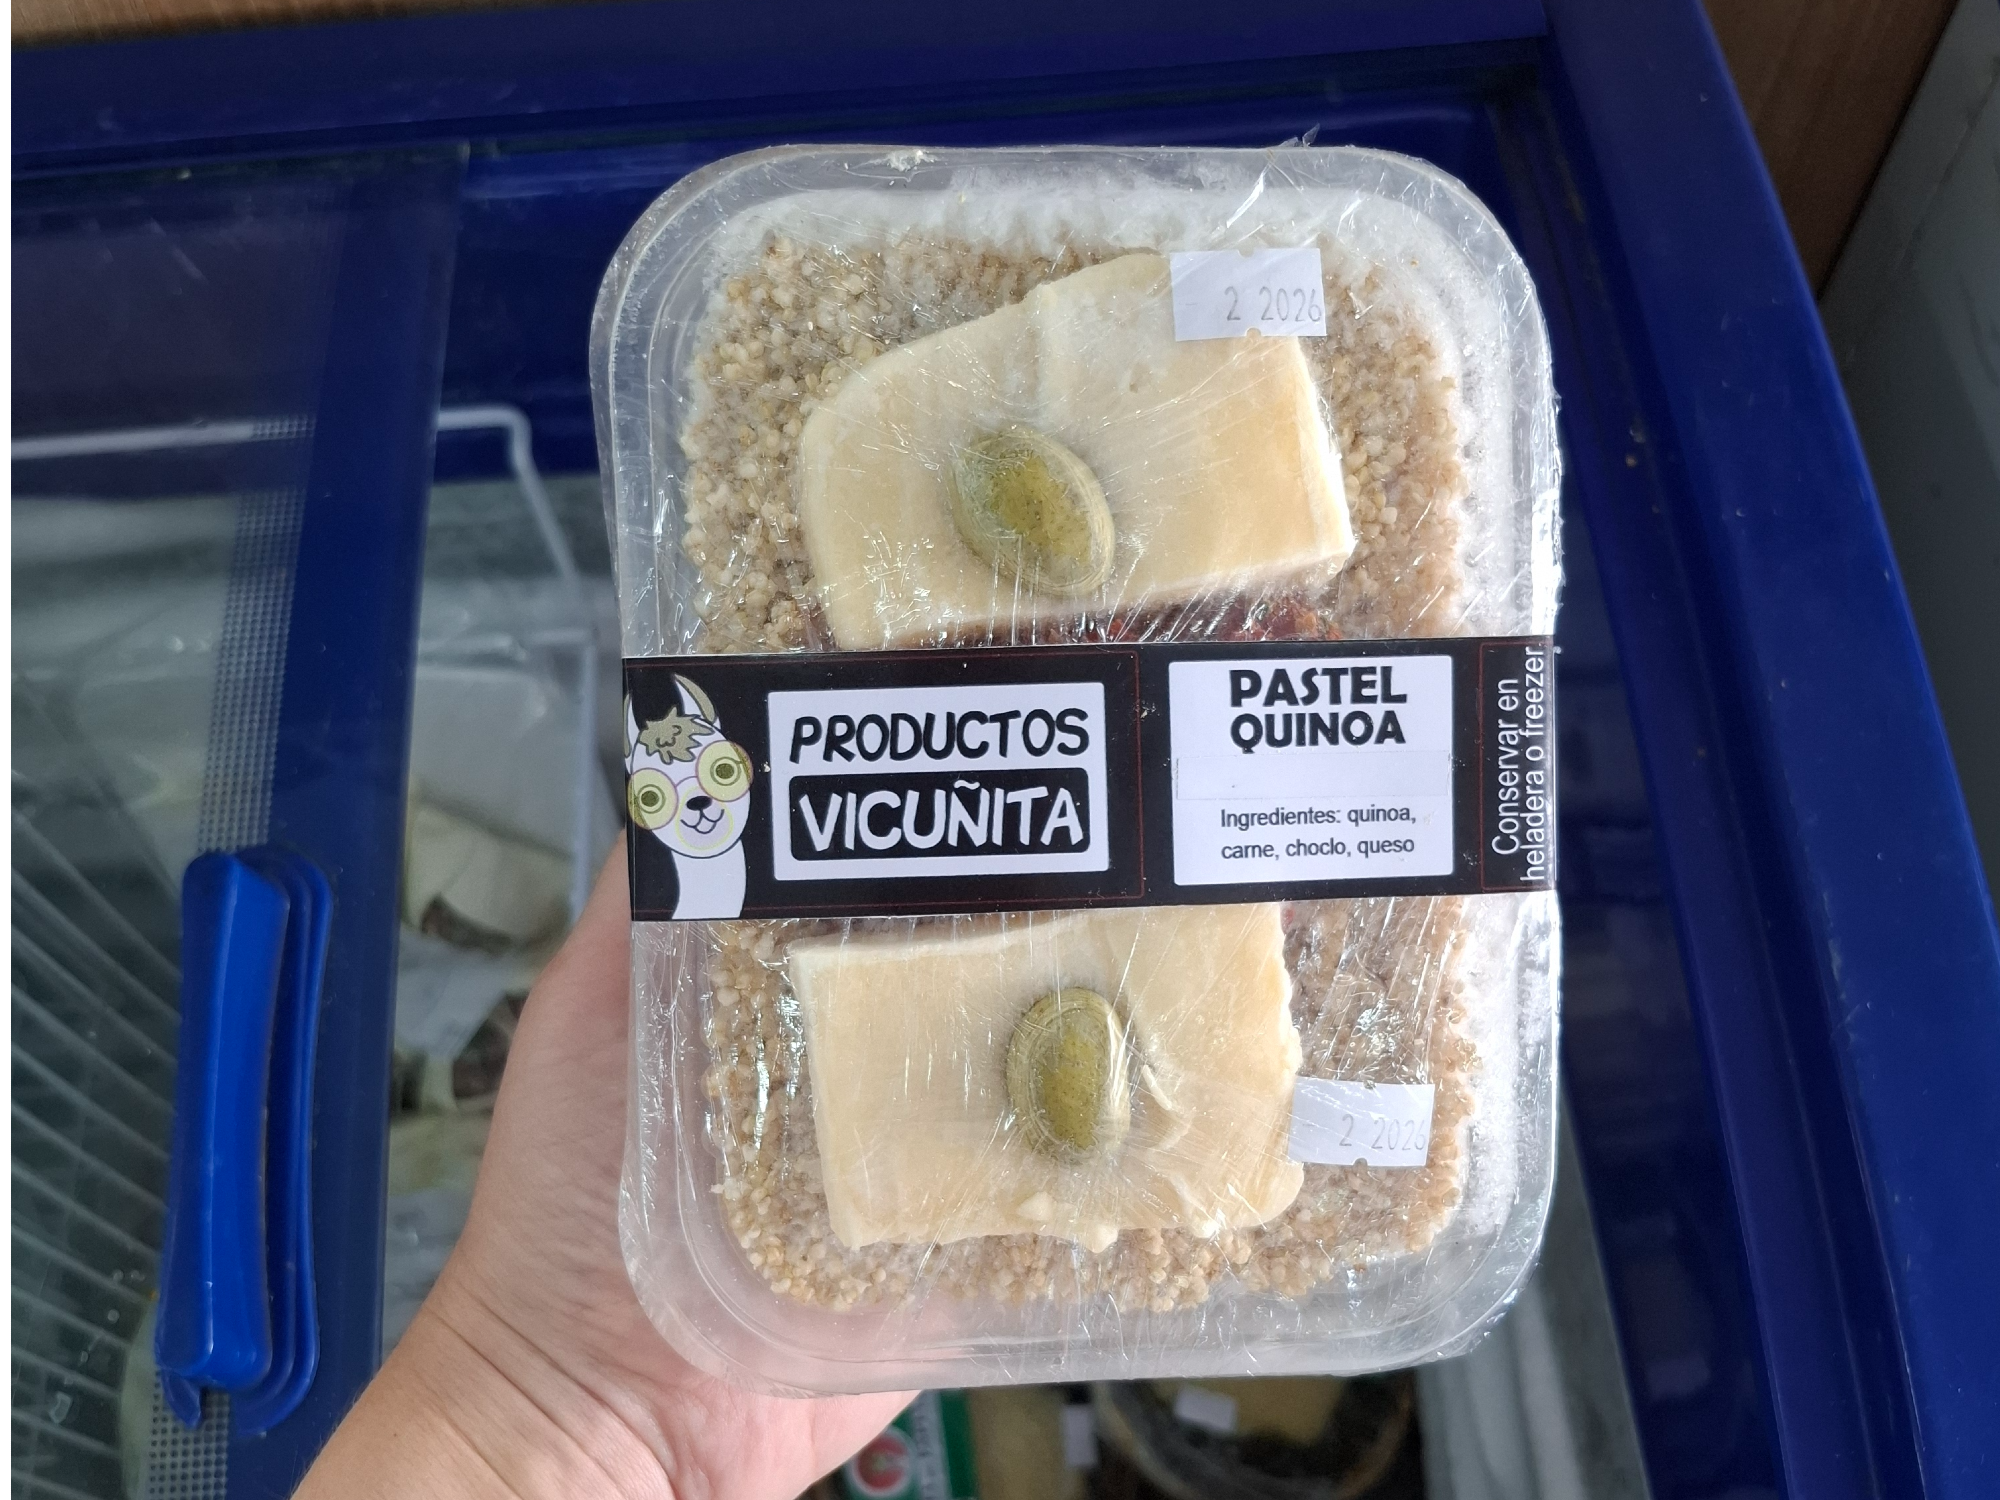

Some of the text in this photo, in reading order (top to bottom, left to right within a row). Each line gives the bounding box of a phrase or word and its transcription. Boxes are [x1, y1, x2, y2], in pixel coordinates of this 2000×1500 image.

[1224, 286, 1323, 322] 2 2026
[1229, 665, 1408, 707] PASTEL
[789, 708, 1090, 763] PRODUCTOS
[1230, 709, 1407, 754] QUINOA
[1491, 678, 1520, 855] Conservar en
[1519, 646, 1545, 881] heladera o freezer
[799, 779, 1084, 851] VICUÑITA
[1220, 804, 1416, 831] Ingredientes: quinoa,
[1221, 837, 1415, 861] carne, choclo, queso
[1339, 1114, 1427, 1151] 2 2026
